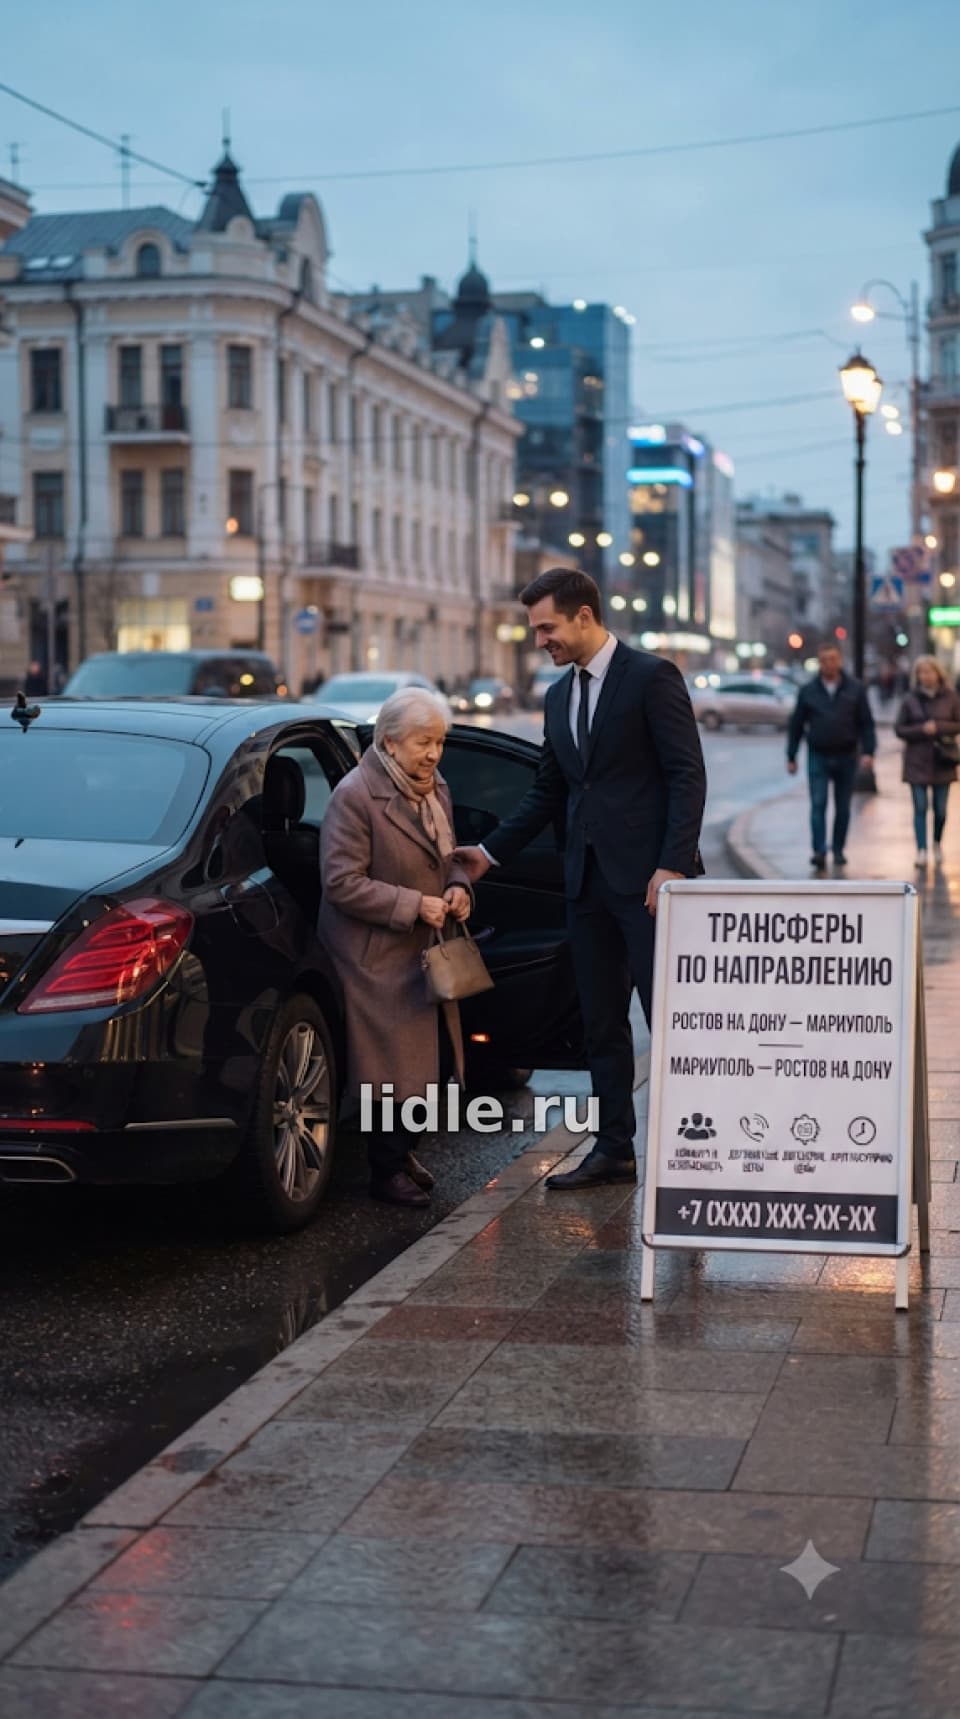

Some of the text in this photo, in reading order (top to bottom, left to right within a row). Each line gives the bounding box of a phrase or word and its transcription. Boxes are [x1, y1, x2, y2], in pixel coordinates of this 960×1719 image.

[708, 912, 863, 944] ТРАНСФЕРЫ
[677, 955, 892, 986] ПО НАПРАВЛЕНИЮ
[672, 1012, 723, 1031] РОСТОВ
[727, 1013, 745, 1031] НА
[748, 1013, 786, 1034] ДОНУ
[806, 1014, 893, 1034] МАРИУПОЛЬ
[670, 1056, 754, 1077] МАРИУПОЛЬ
[775, 1058, 827, 1078] РОСТОВ
[831, 1060, 849, 1079] НА
[852, 1061, 892, 1081] ДОНУ
[677, 1200, 702, 1225] +7
